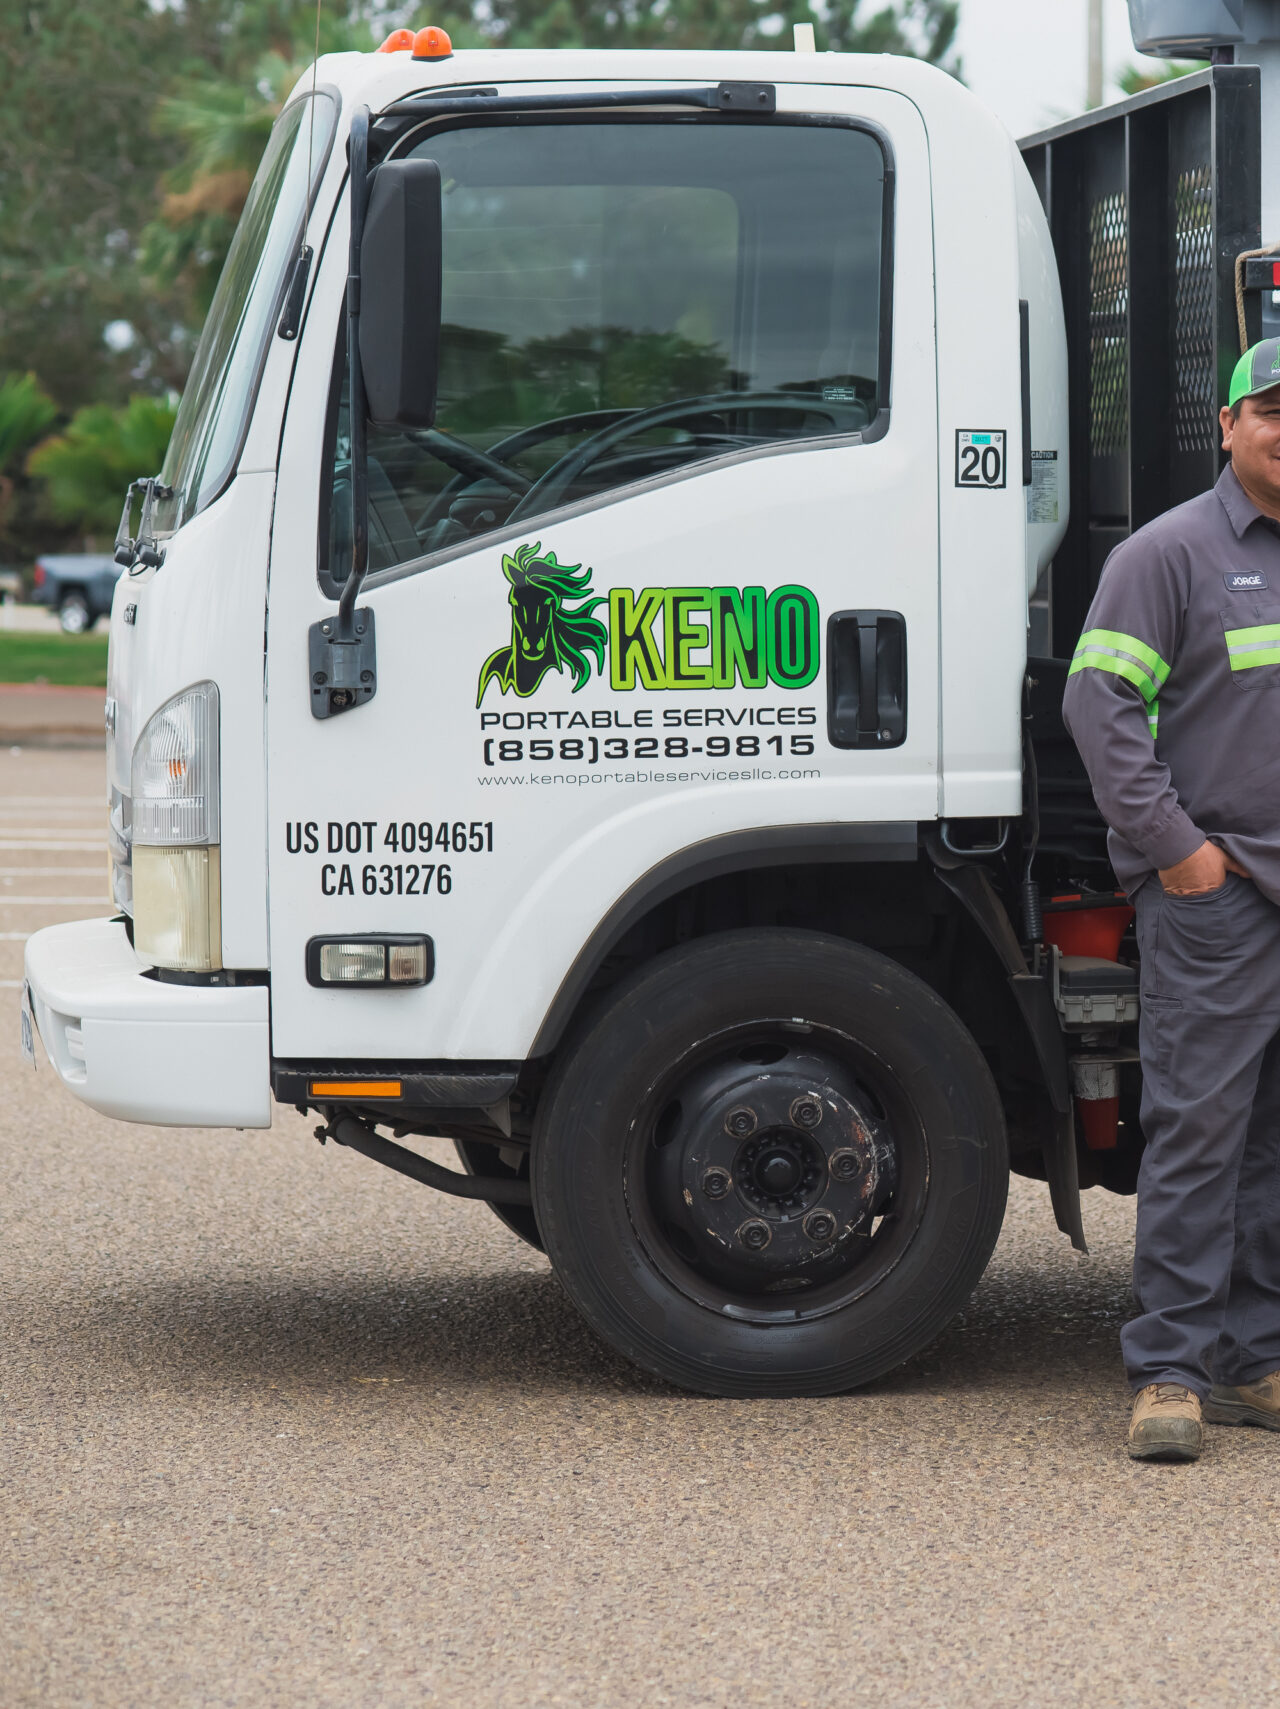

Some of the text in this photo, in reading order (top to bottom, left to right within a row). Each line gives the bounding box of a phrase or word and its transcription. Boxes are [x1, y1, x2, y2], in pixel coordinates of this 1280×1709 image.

[960, 445, 1001, 484] 20
[1031, 451, 1054, 459] CAUTION
[1232, 575, 1262, 586] JORGE
[608, 584, 821, 691] KENO
[480, 706, 817, 731] PORTABLE SERVICES
[483, 734, 816, 766] (858)328-9815
[477, 767, 821, 787] www.kenoportableservicesllc.com
[286, 822, 493, 853] US DOT 4094651
[321, 864, 452, 896] CA 631276
